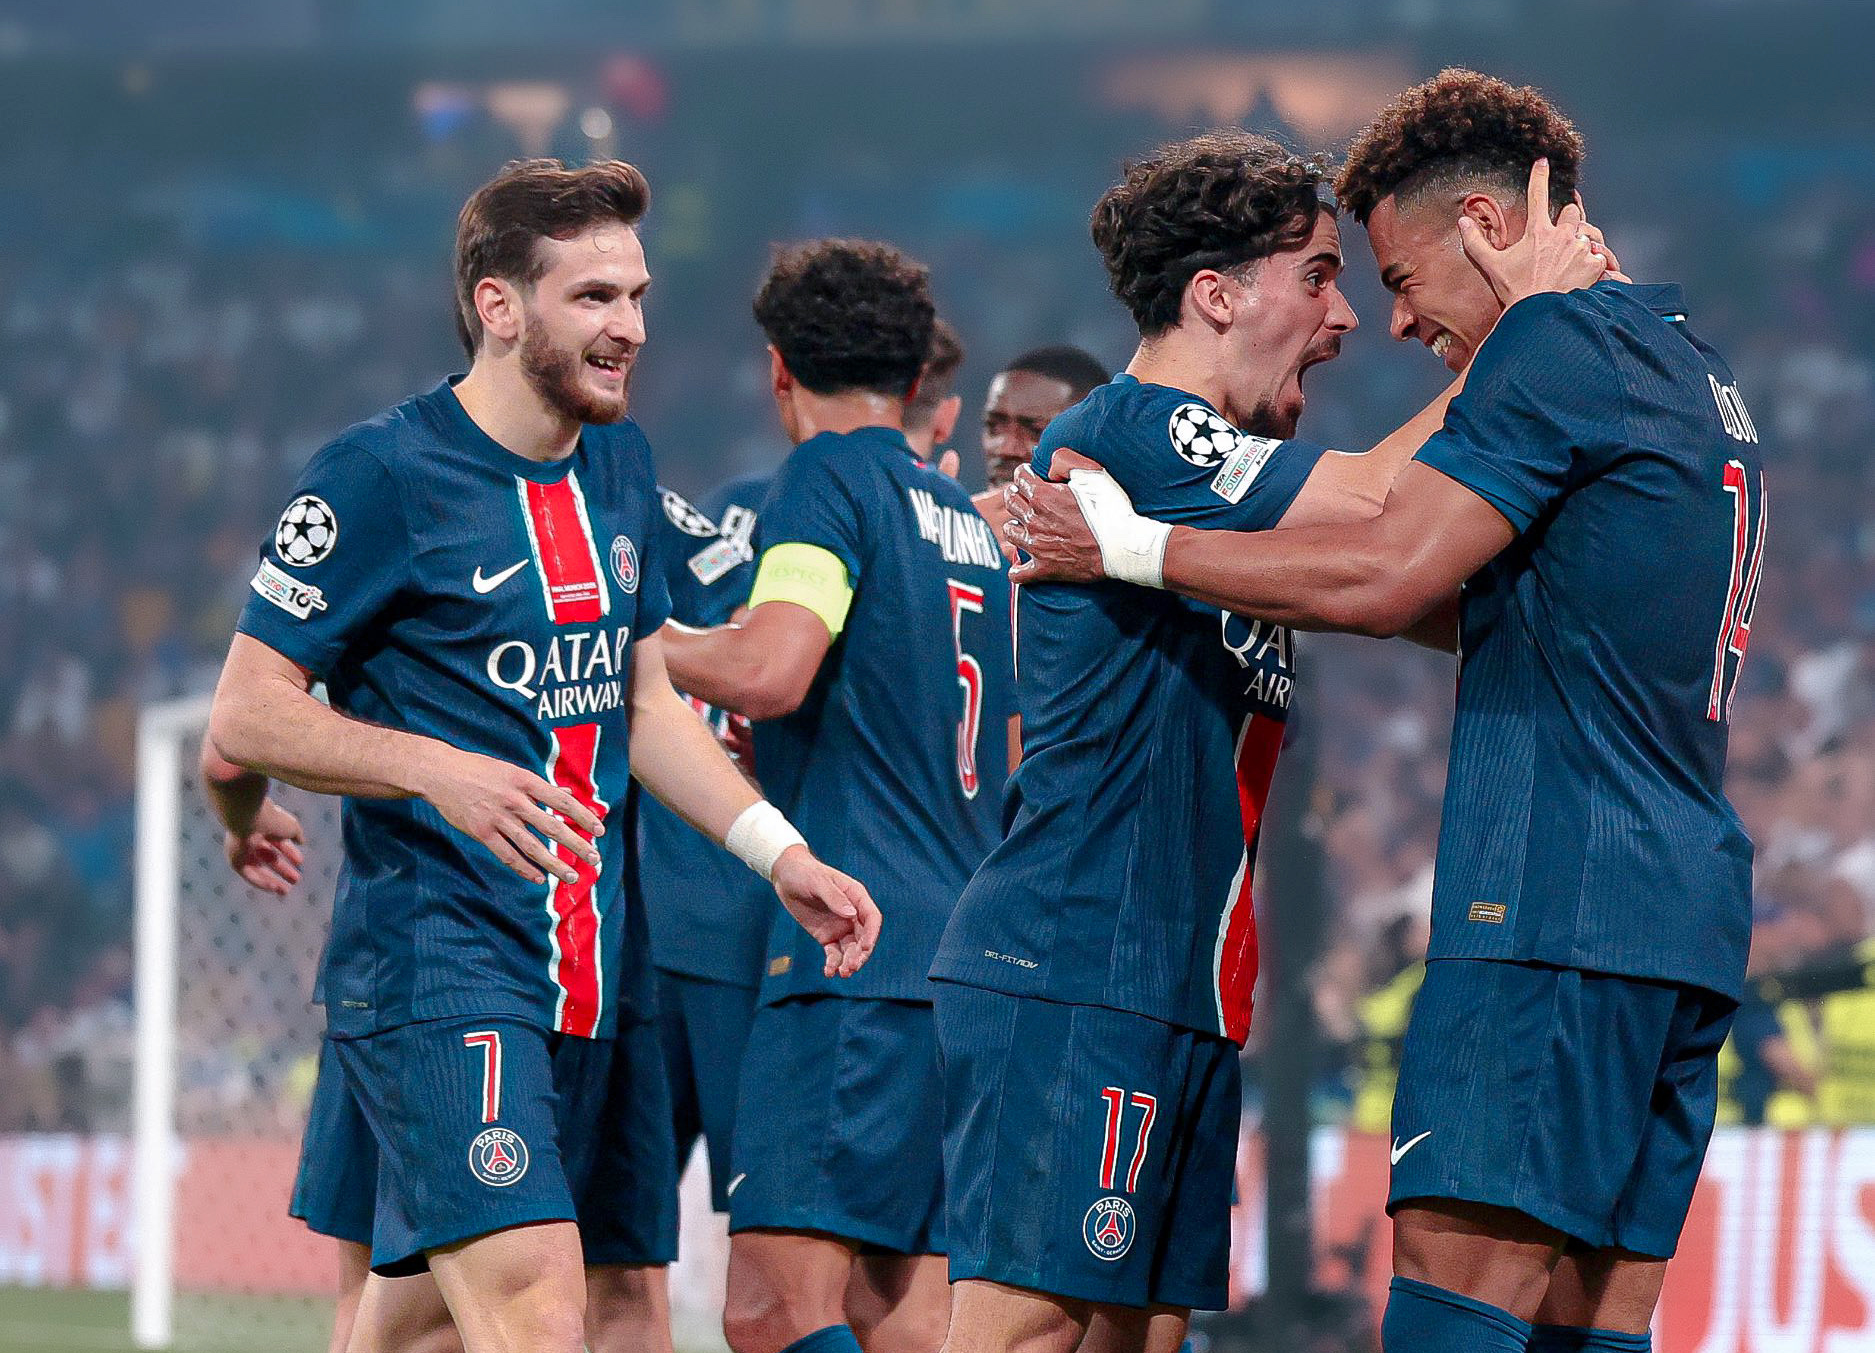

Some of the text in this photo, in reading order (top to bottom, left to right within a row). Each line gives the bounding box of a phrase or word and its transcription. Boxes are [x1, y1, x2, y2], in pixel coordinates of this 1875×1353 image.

[537, 679, 625, 721] AIRWAY
[946, 577, 985, 801] 5
[1243, 668, 1297, 710] AIR
[463, 1030, 502, 1124] 7
[476, 1130, 516, 1148] PARIS
[1100, 1086, 1157, 1194] 17
[1095, 1200, 1131, 1217] PARIS
